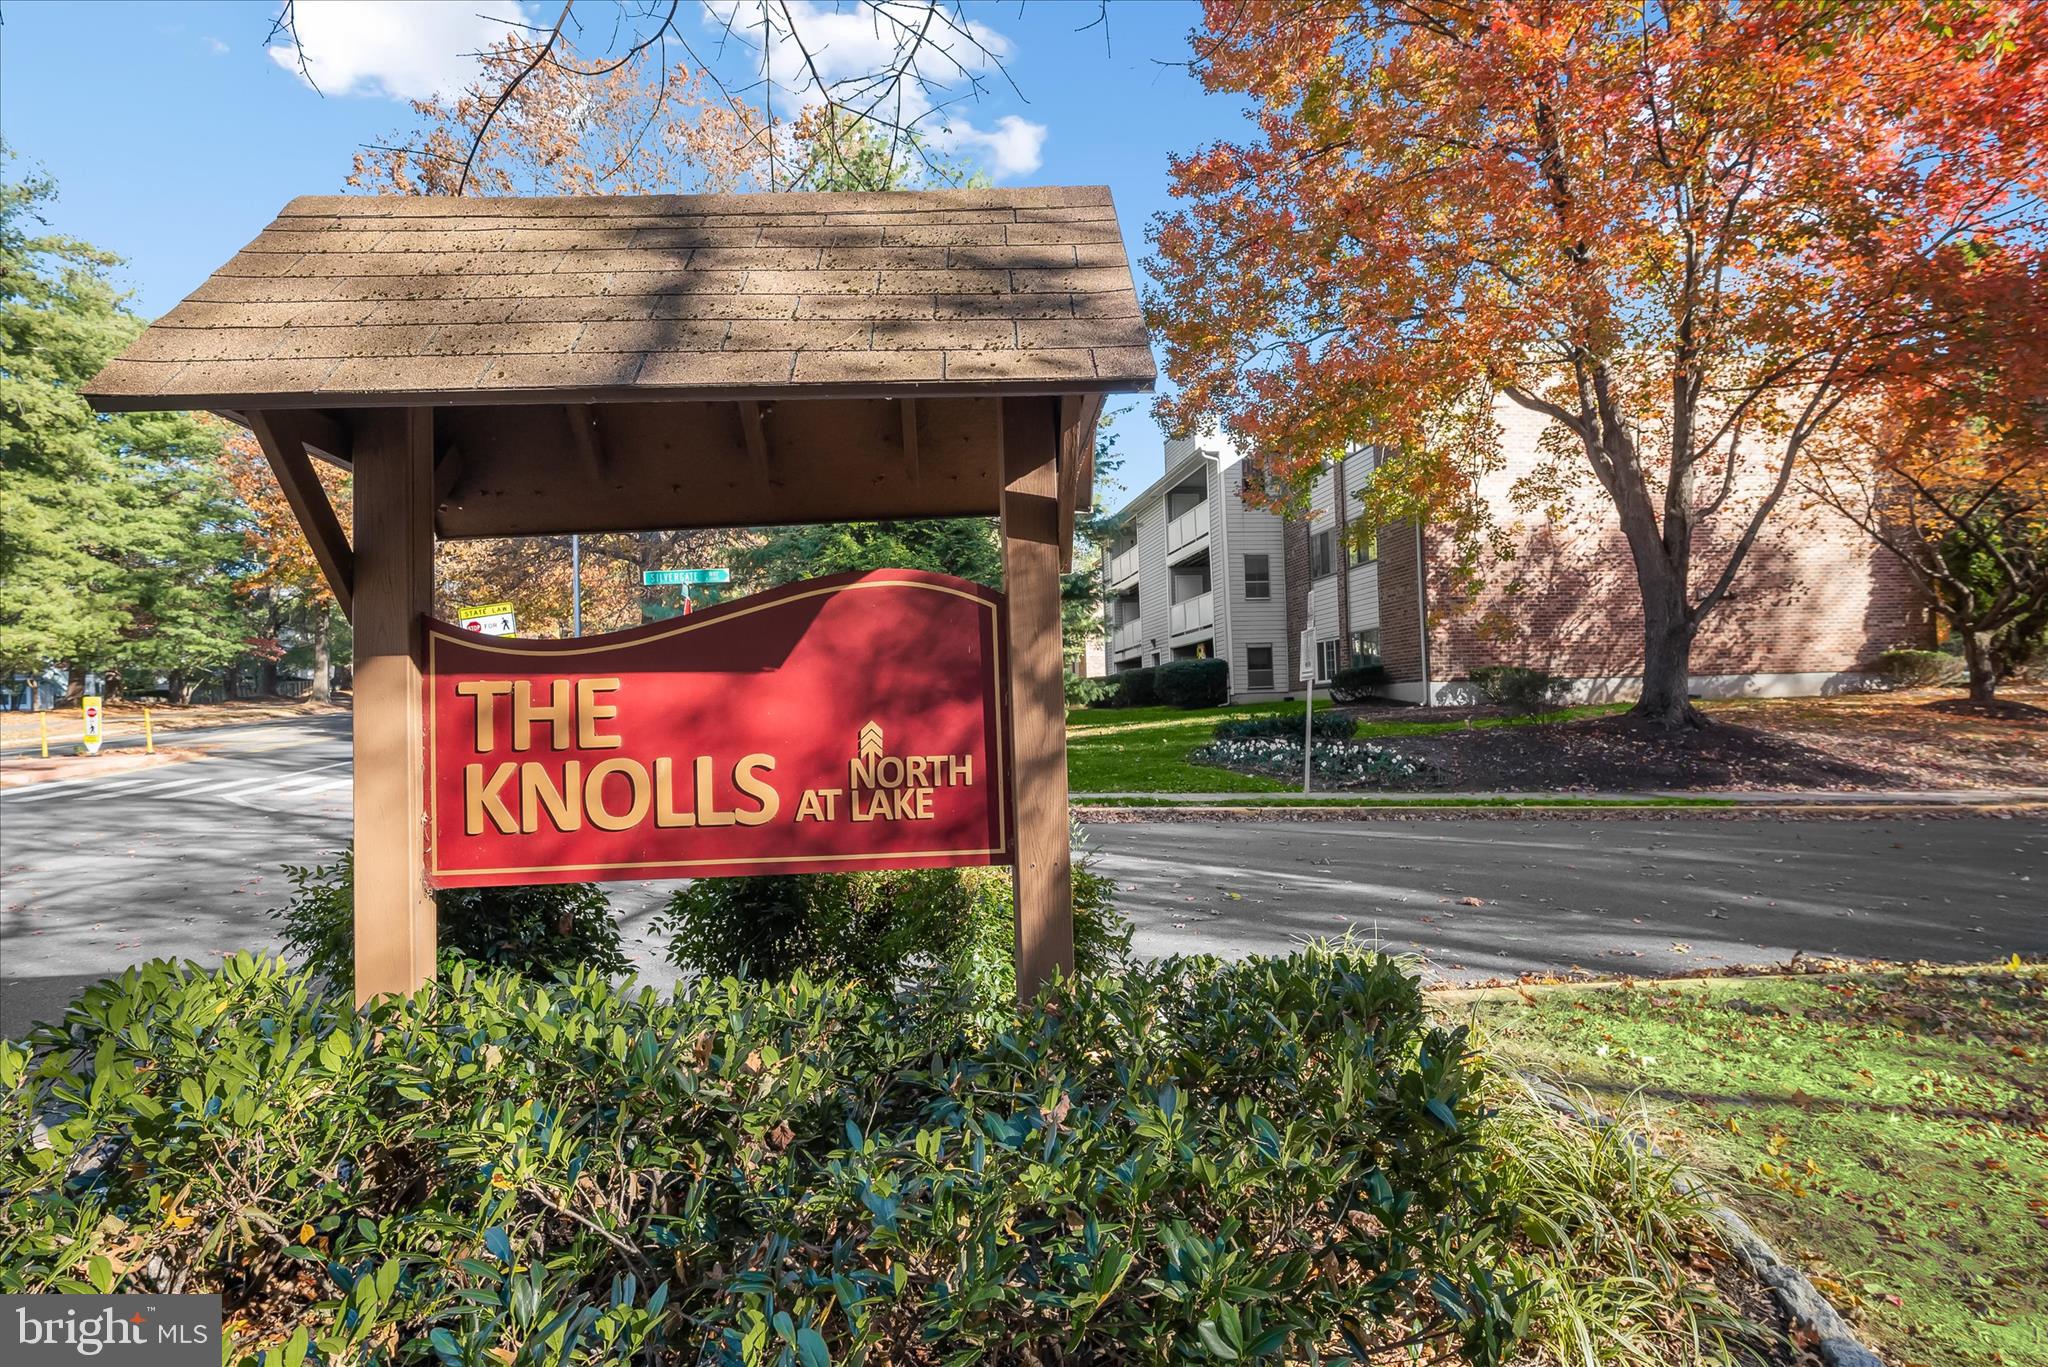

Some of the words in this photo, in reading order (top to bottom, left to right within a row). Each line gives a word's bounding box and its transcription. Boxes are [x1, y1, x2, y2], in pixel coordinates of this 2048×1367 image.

[650, 572, 698, 583] SILVERGATE
[464, 608, 487, 617] STATE
[492, 606, 507, 614] LAW
[457, 677, 622, 752] THE
[850, 754, 973, 789] NORTH
[465, 753, 780, 835] KNOLLS
[795, 789, 842, 822] AT
[851, 787, 935, 821] LAKE
